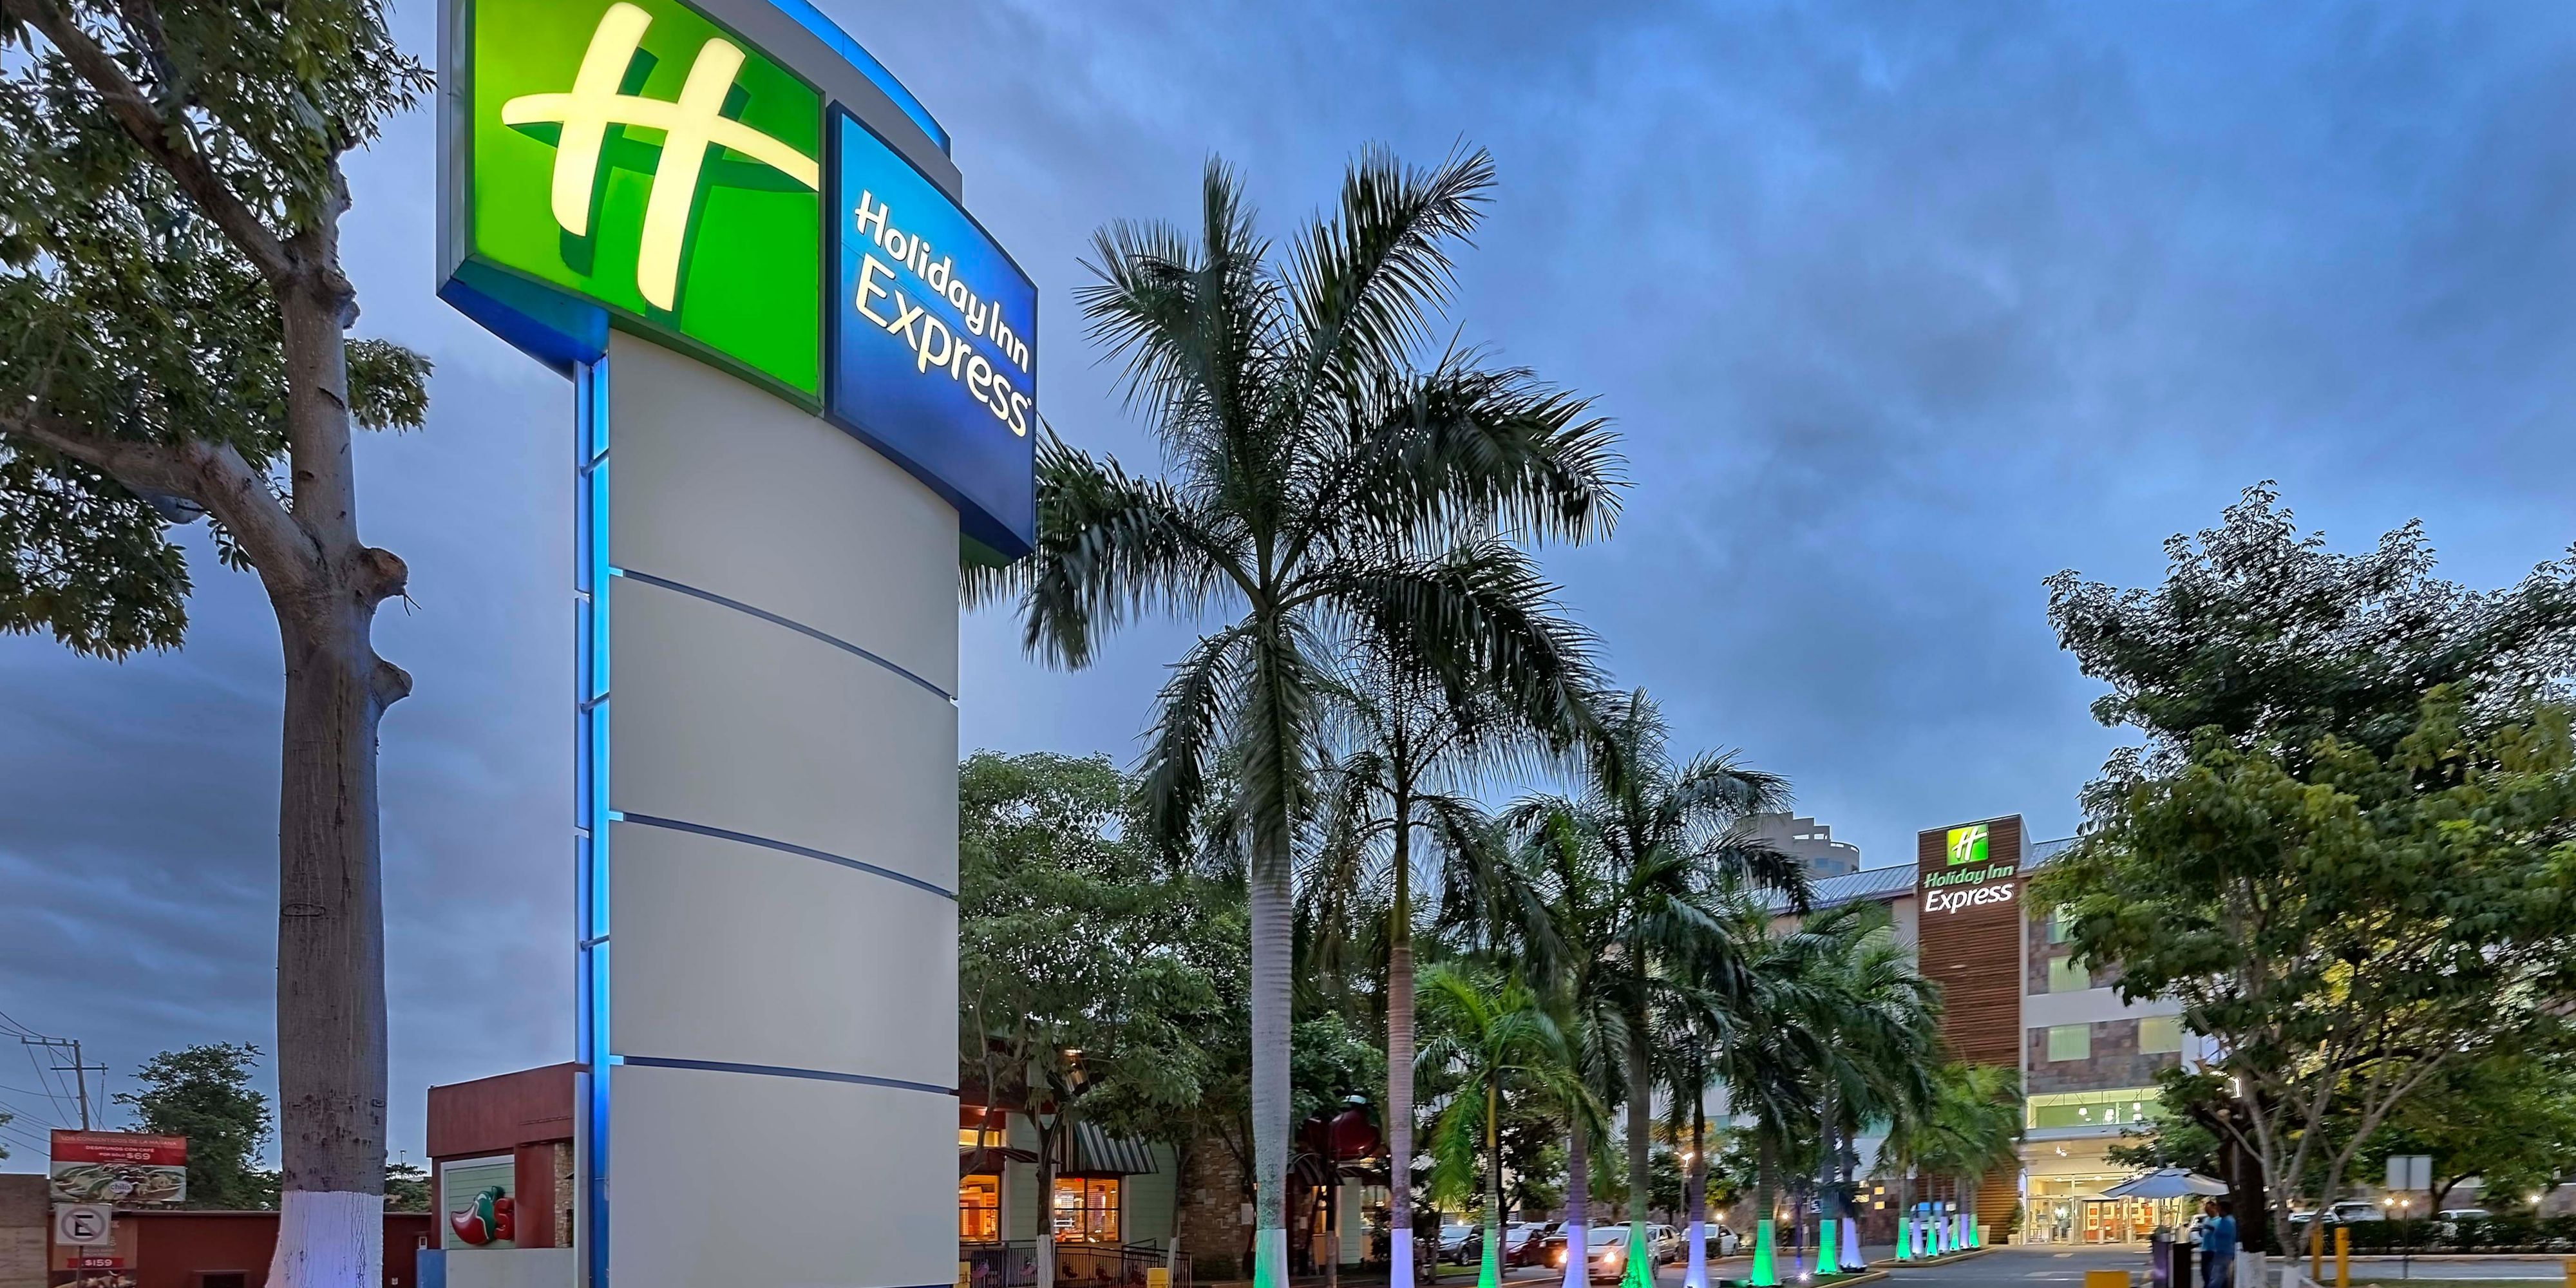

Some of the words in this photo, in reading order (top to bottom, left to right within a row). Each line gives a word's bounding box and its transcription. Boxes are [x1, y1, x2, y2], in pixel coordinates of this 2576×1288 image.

[854, 189, 987, 336] Holiday
[989, 301, 1029, 373] Inn
[855, 252, 1028, 437] Express
[1924, 867, 1987, 888] Holiday
[1987, 864, 2014, 879] Inn
[1924, 883, 2014, 914] Express
